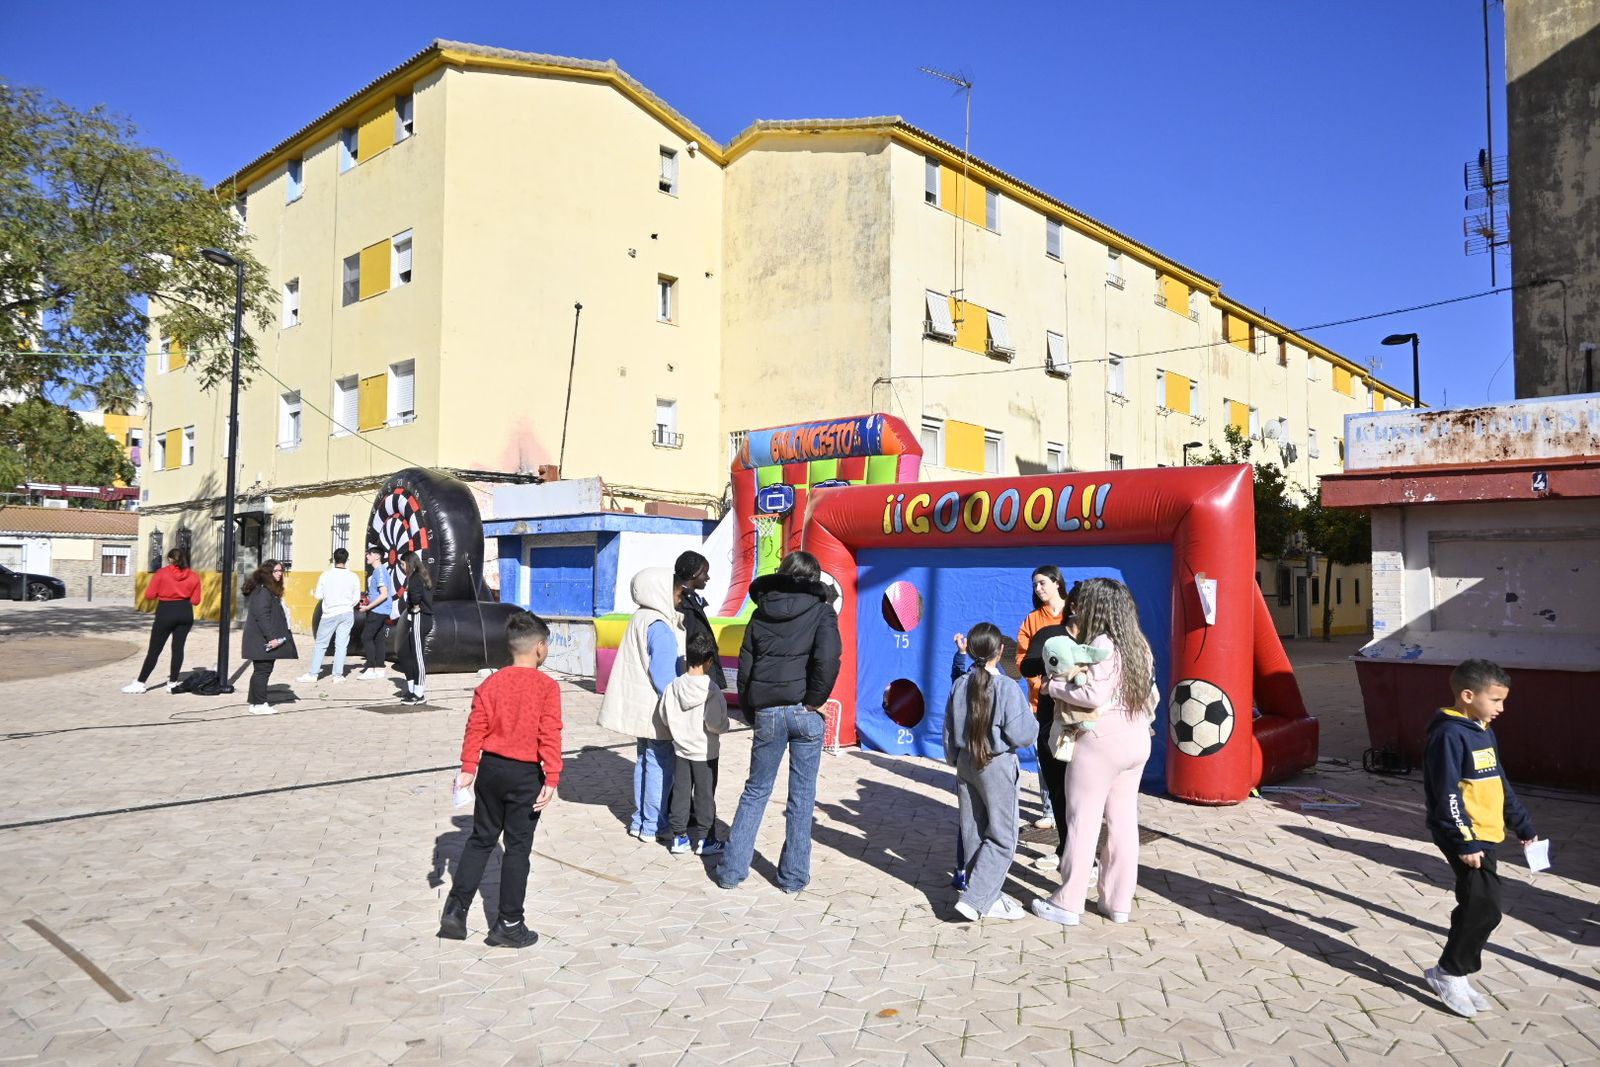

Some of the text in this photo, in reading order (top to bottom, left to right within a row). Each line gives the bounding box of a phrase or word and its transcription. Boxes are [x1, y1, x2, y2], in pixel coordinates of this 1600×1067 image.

[770, 421, 856, 464] BALONCESTO
[1532, 473, 1546, 490] 4
[893, 633, 910, 649] 75
[896, 728, 914, 745] 25
